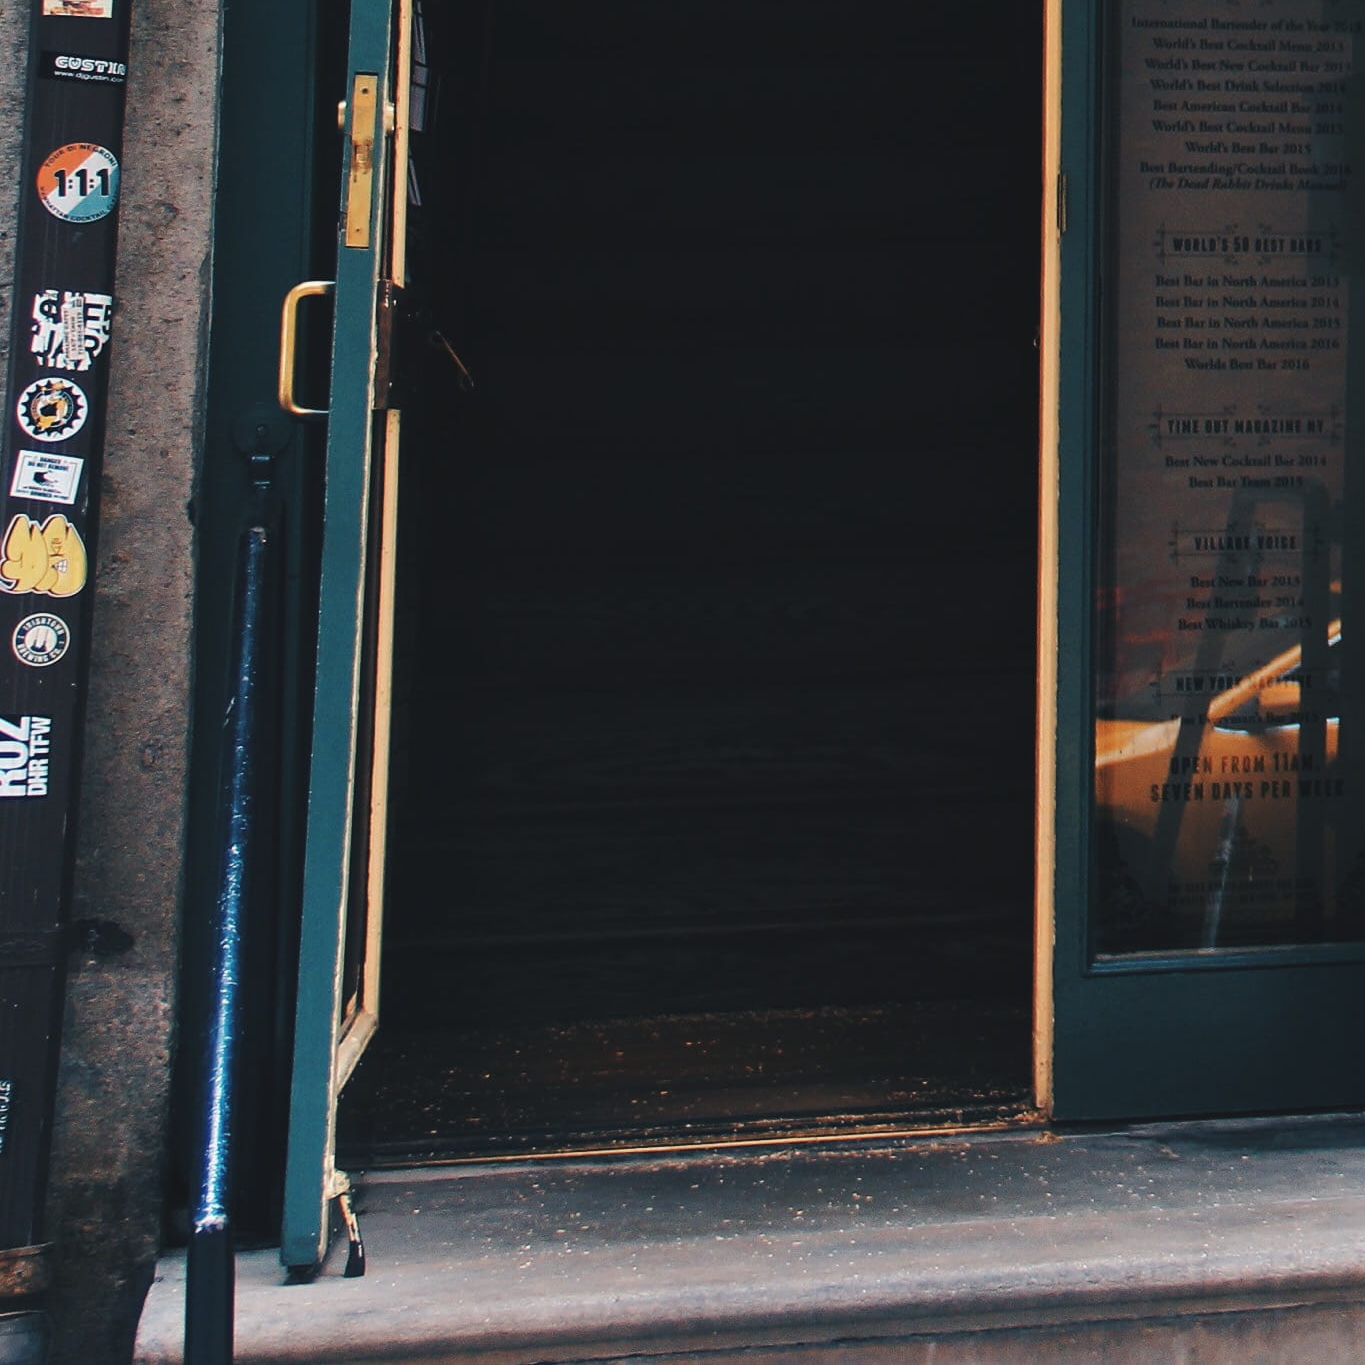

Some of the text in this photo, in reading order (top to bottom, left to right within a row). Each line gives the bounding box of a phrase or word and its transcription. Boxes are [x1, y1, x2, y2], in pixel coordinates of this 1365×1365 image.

[54, 168, 110, 197] 1:1:1
[27, 716, 51, 796] DHR TFW
[1170, 755, 1213, 775] OPEN
[1220, 755, 1266, 774] FROM
[1151, 782, 1205, 803] SEVEN
[1211, 781, 1254, 800] DAYS
[1260, 780, 1292, 798] PER
